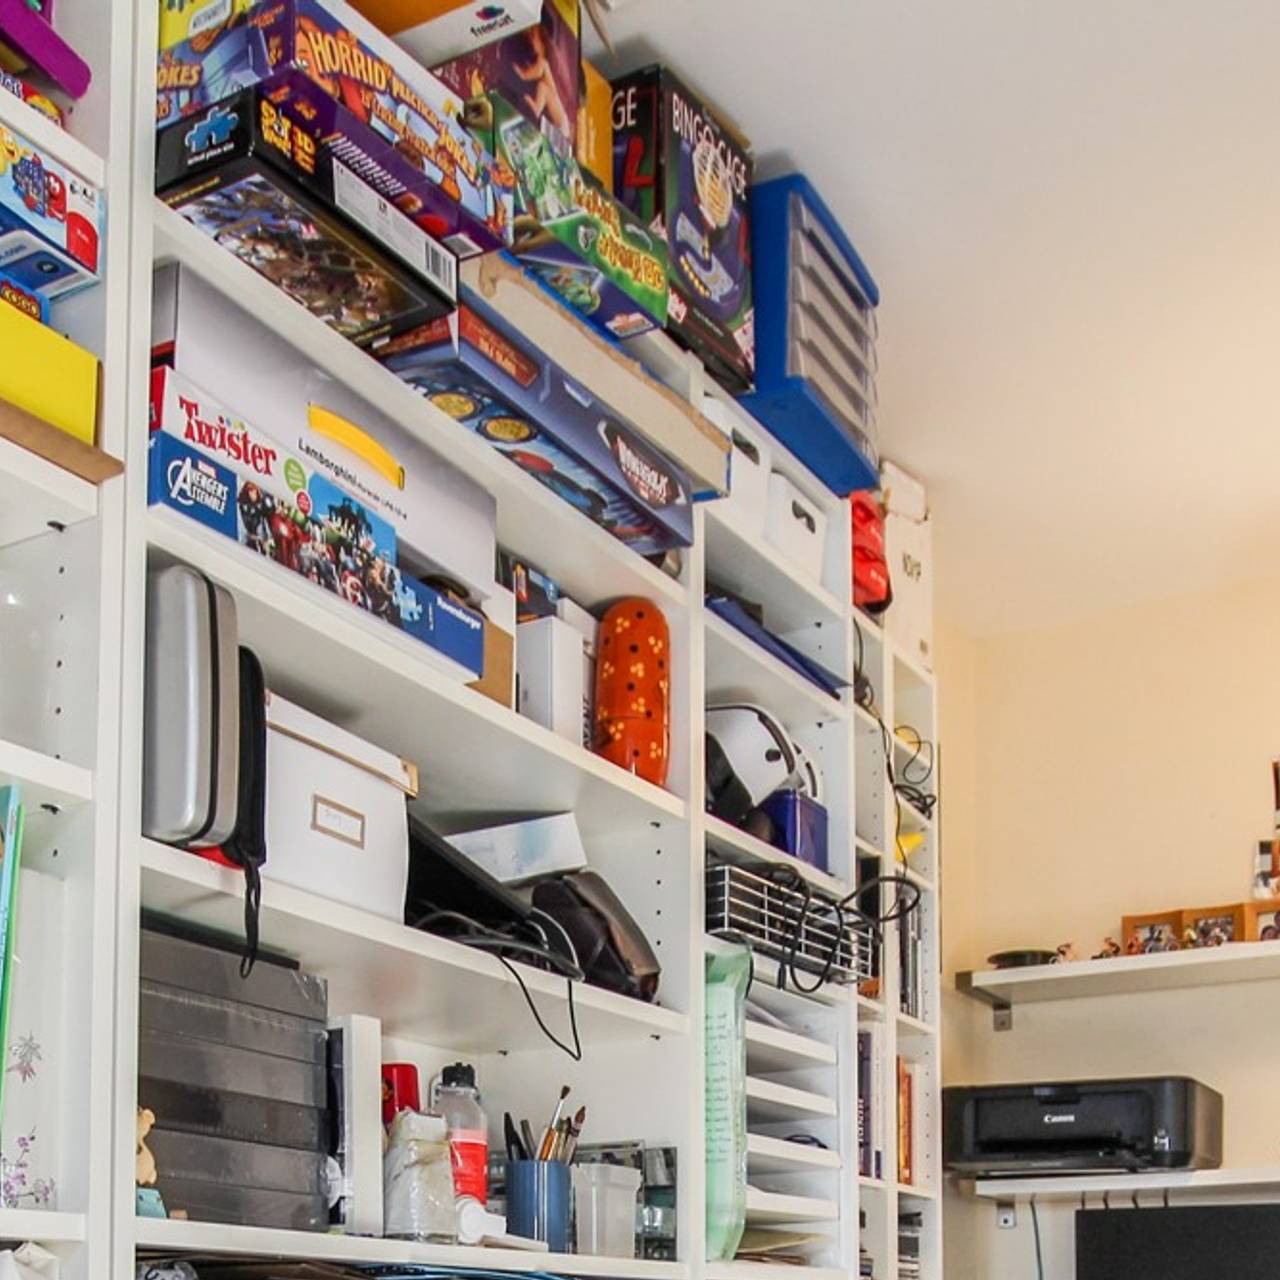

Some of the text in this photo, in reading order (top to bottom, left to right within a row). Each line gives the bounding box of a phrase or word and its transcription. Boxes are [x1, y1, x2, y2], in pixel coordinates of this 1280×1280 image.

[157, 62, 203, 88] OKES
[308, 28, 388, 91] HORRID
[672, 92, 748, 201] BINGO CAGE
[178, 396, 277, 477] Twister
[1043, 1113, 1076, 1124] Canon
